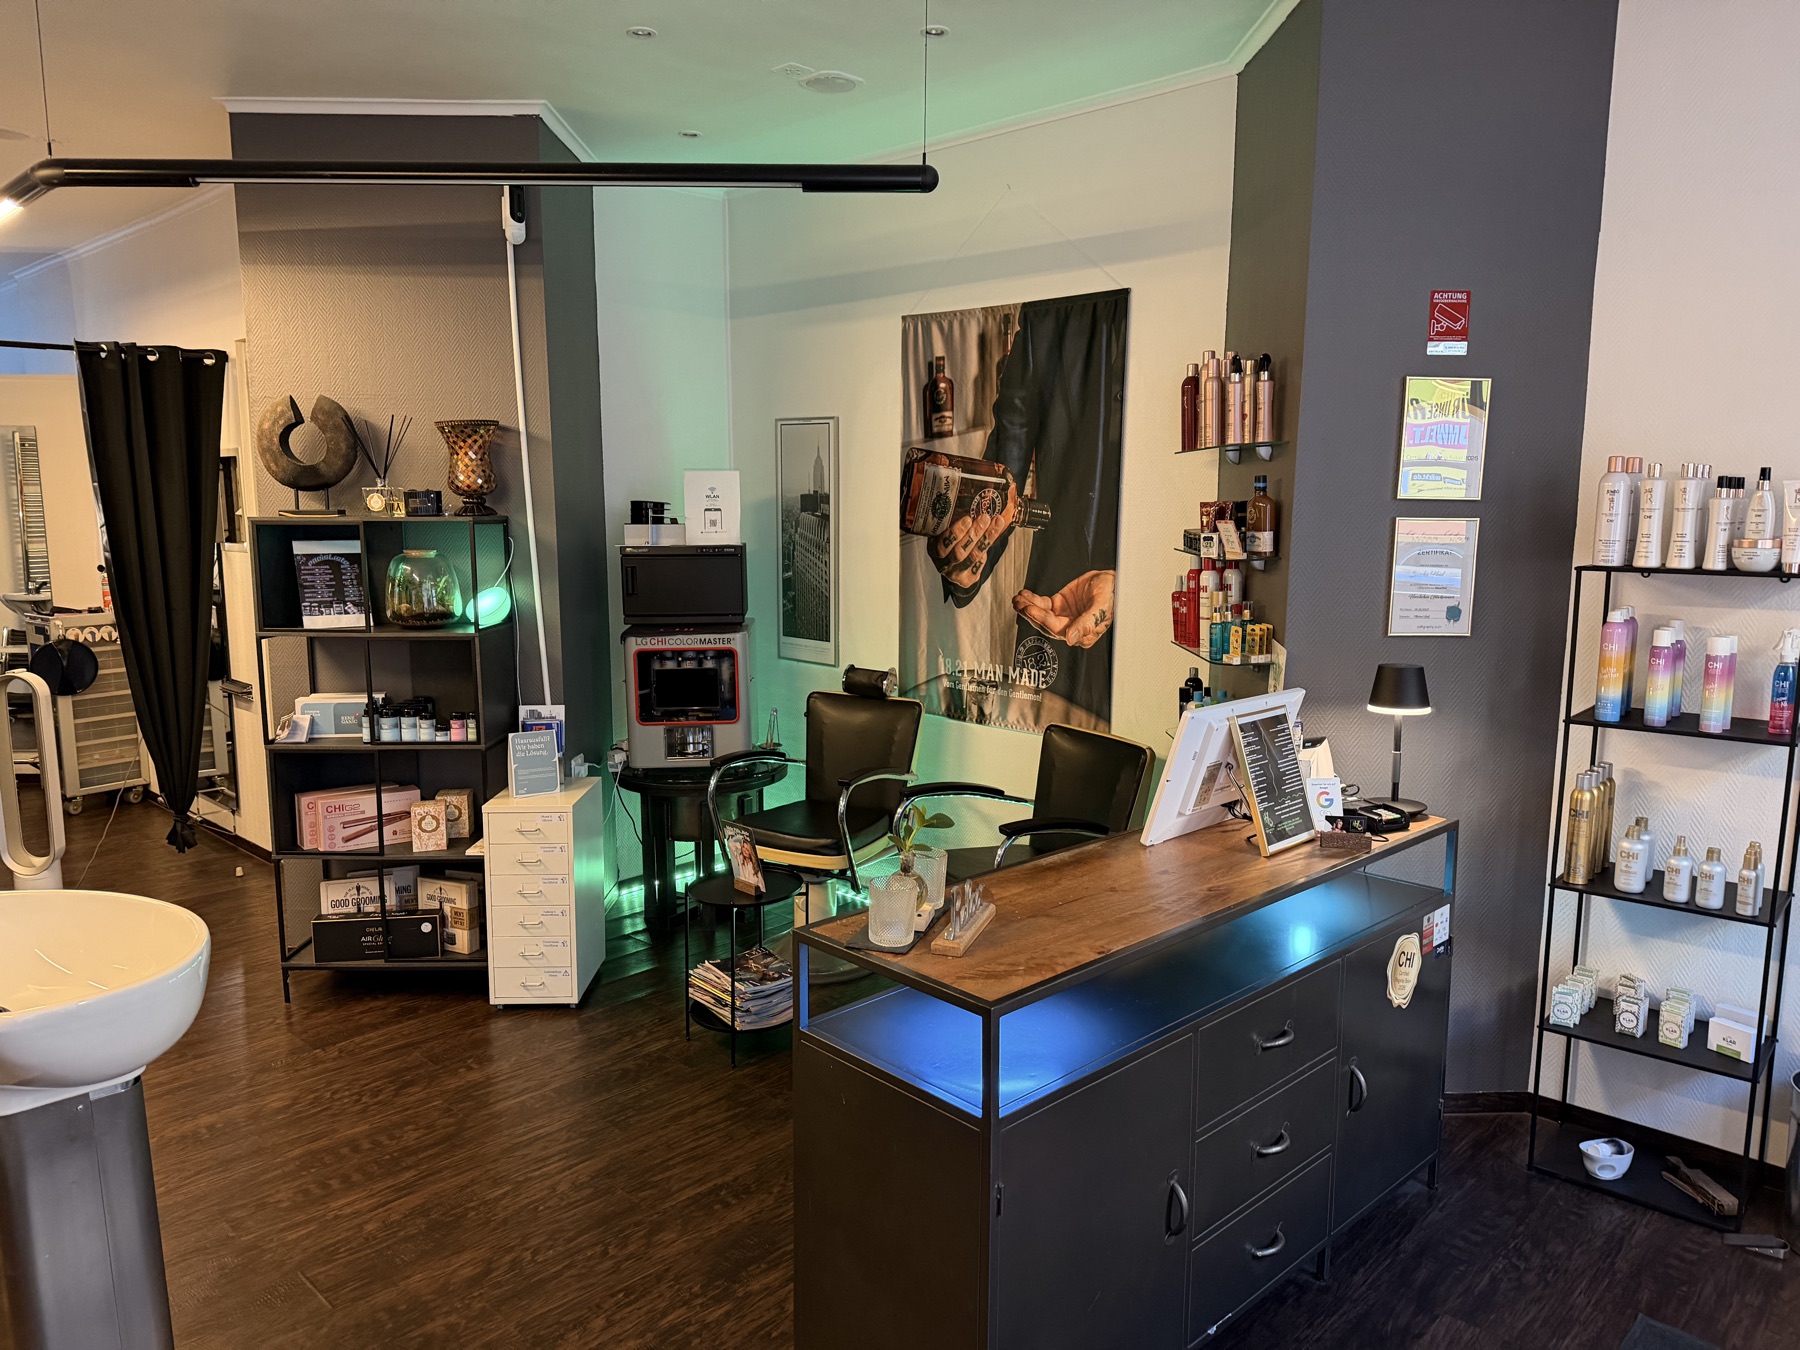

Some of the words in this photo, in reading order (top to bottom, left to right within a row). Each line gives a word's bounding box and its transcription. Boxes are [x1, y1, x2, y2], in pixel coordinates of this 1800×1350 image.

[1433, 292, 1467, 300] ACHTUNG
[635, 638, 648, 646] LG
[1602, 642, 1618, 651] CHI
[1650, 657, 1665, 665] CHI
[1707, 661, 1723, 669] CHI
[938, 656, 968, 678] 18.21
[973, 661, 1004, 683] MAN
[1007, 665, 1047, 689] MADE
[1774, 680, 1790, 688] CHI
[514, 735, 551, 744] Haarausfall?
[325, 803, 345, 814] CHI
[344, 803, 361, 811] G2
[1569, 808, 1589, 820] CHI
[1619, 850, 1639, 861] CHI
[1666, 866, 1681, 875] CHI
[1699, 871, 1715, 881] CHI
[1738, 876, 1753, 885] CHI
[330, 898, 350, 909] GOOD
[351, 894, 388, 907] GROOMIG
[426, 893, 437, 902] GOOD
[1398, 950, 1416, 969] CHI
[1722, 1036, 1737, 1046] KLAR
